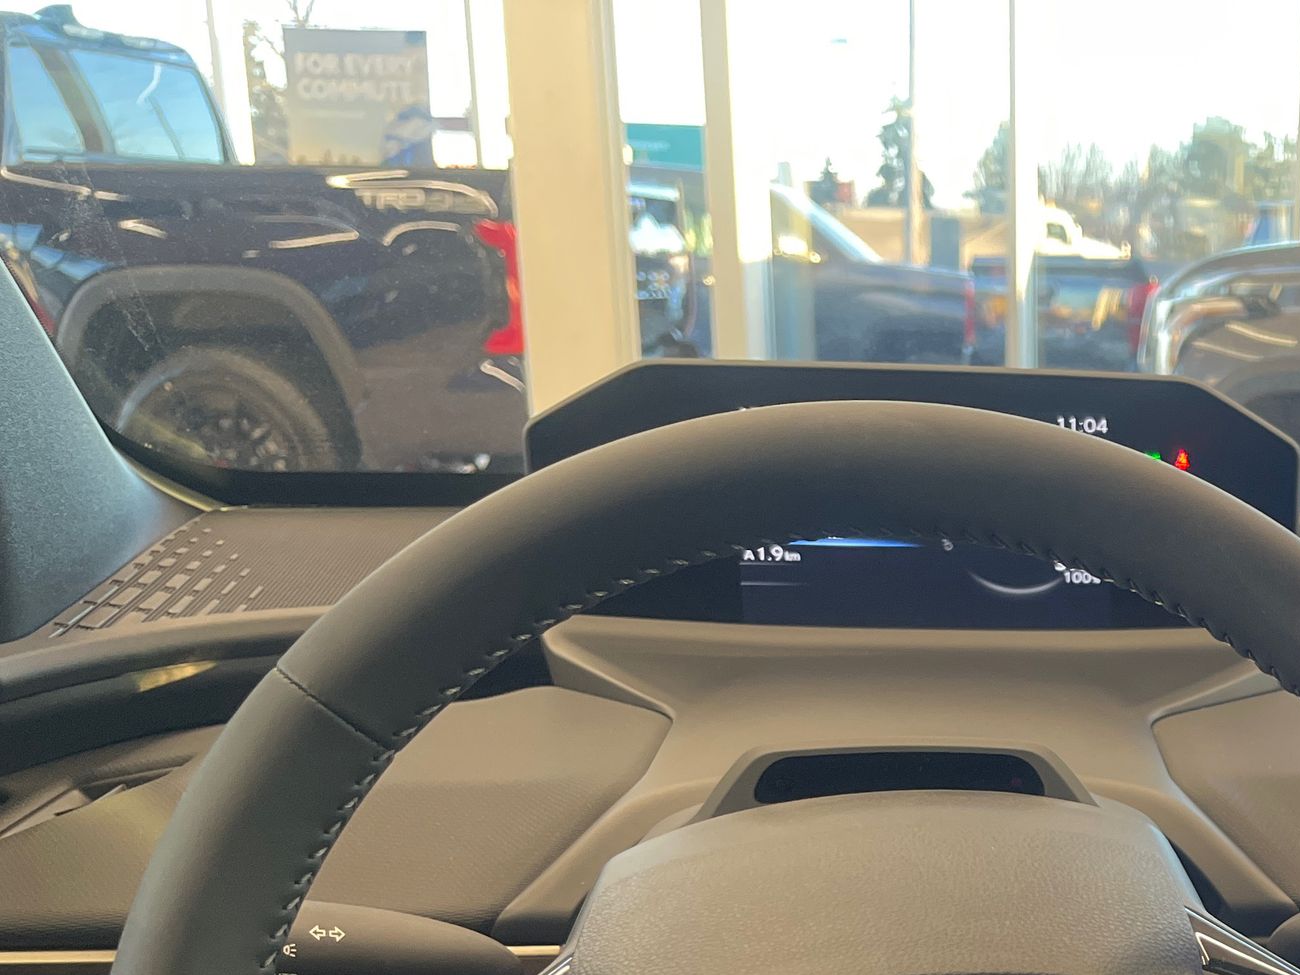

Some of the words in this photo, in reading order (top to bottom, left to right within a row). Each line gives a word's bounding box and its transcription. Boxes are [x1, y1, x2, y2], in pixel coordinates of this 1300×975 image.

[294, 52, 340, 75] FOR
[1056, 416, 1109, 434] 11:04
[756, 544, 784, 562] 1.9
